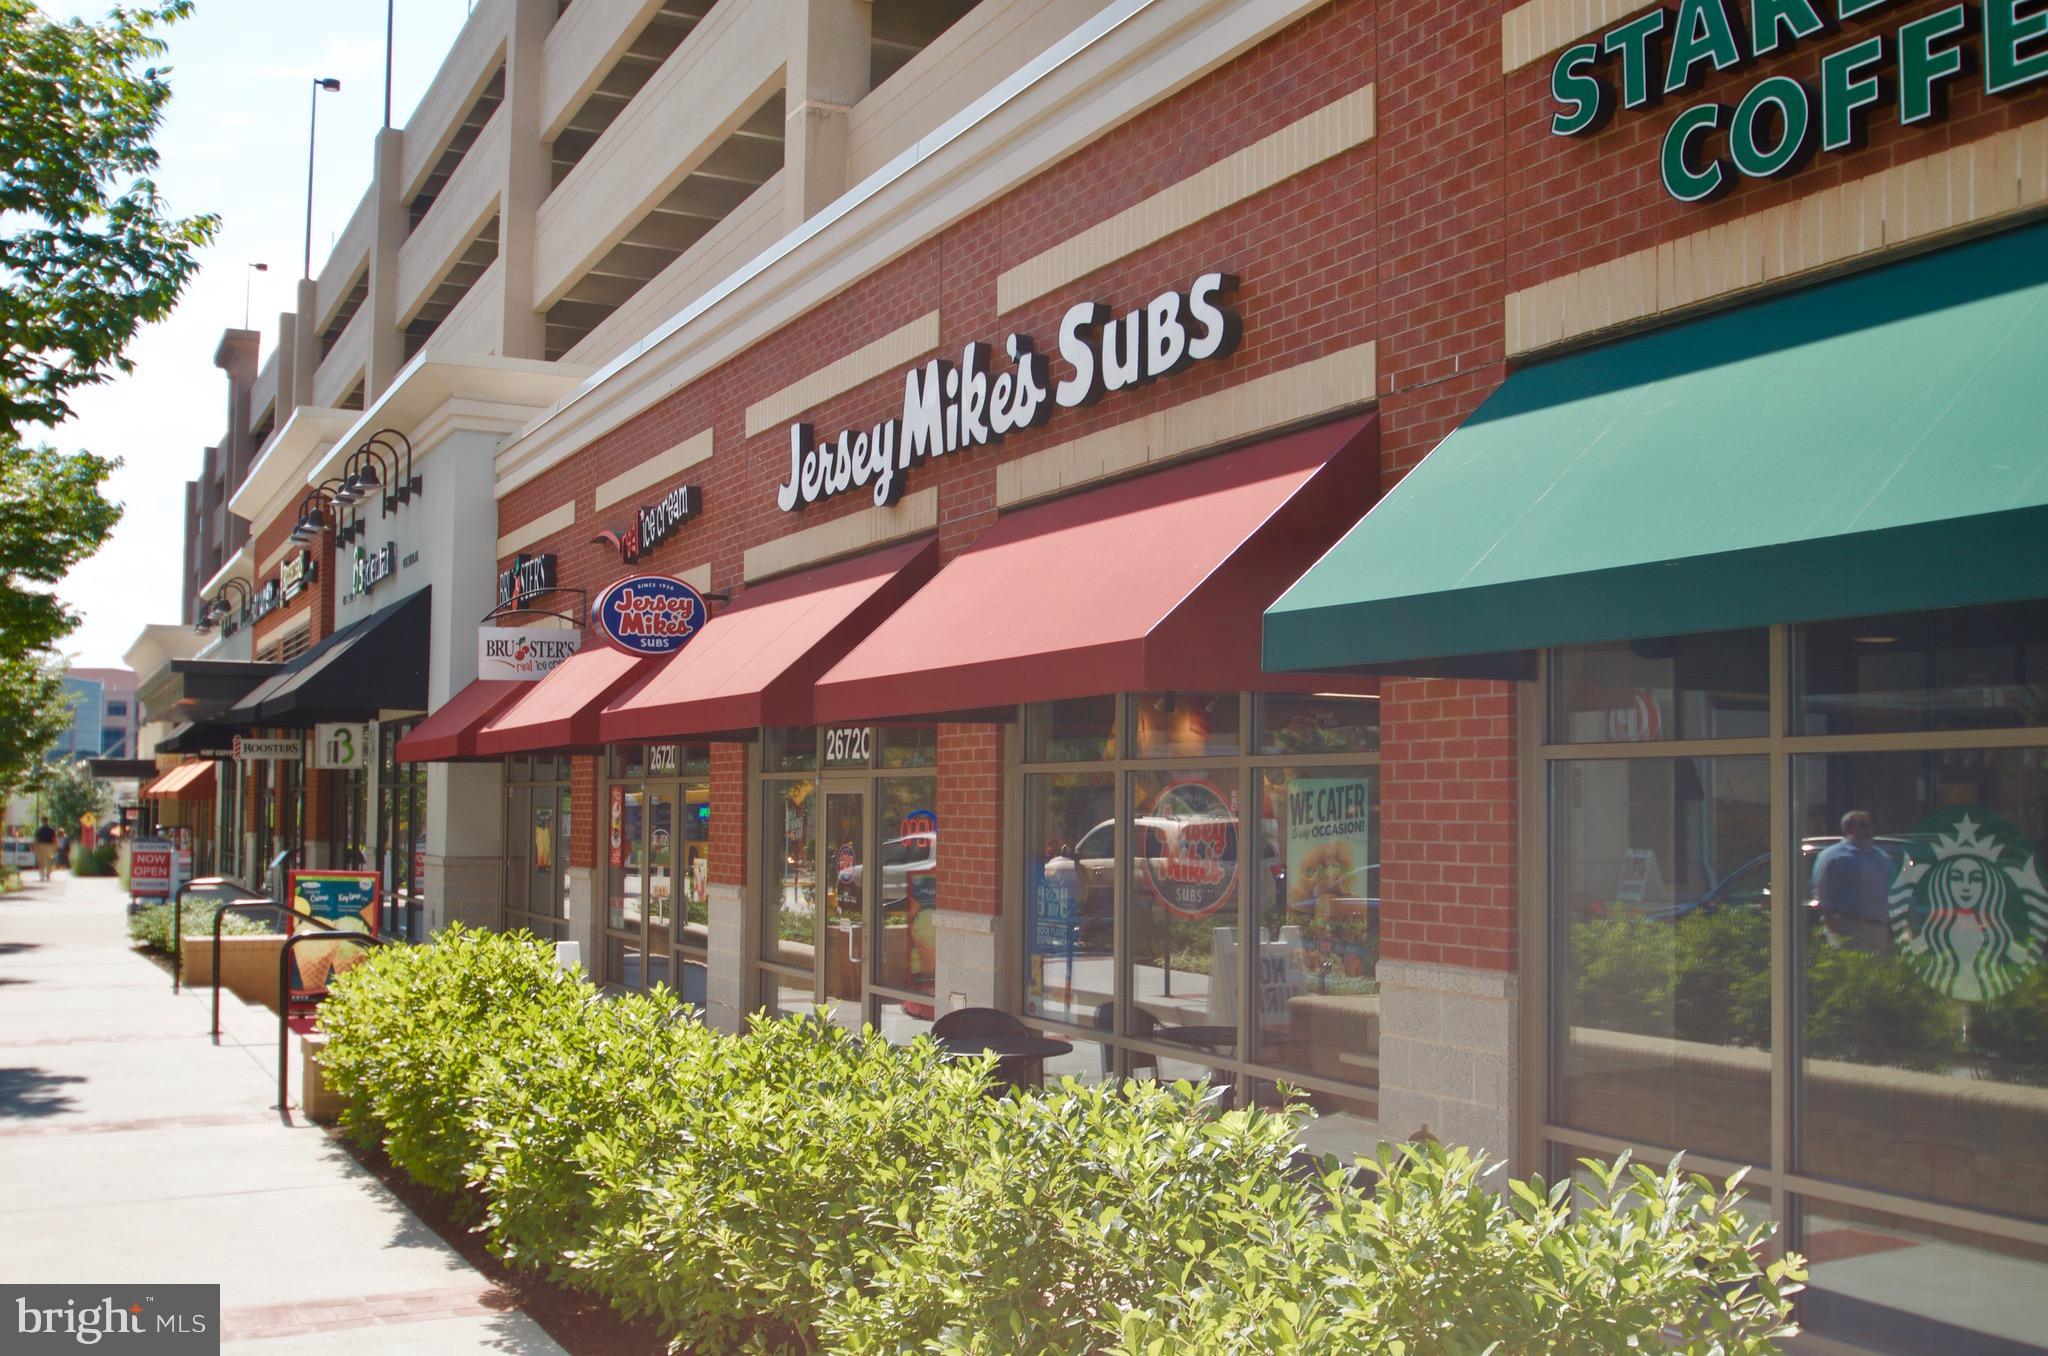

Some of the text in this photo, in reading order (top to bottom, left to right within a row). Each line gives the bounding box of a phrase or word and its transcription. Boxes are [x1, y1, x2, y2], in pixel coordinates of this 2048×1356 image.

[777, 272, 1226, 512] Jersey Mike's SUBS
[656, 484, 688, 537] cream
[614, 588, 694, 620] Jersey
[619, 612, 693, 637] Mike's
[640, 638, 669, 648] SUBS
[516, 660, 533, 673] real
[244, 742, 298, 753] ROOSTERS
[1289, 783, 1366, 827] WE CATER
[1311, 820, 1365, 838] OCCASION!
[137, 854, 166, 863] NOW
[134, 866, 167, 877] OPEN
[1176, 887, 1203, 902] SUBS
